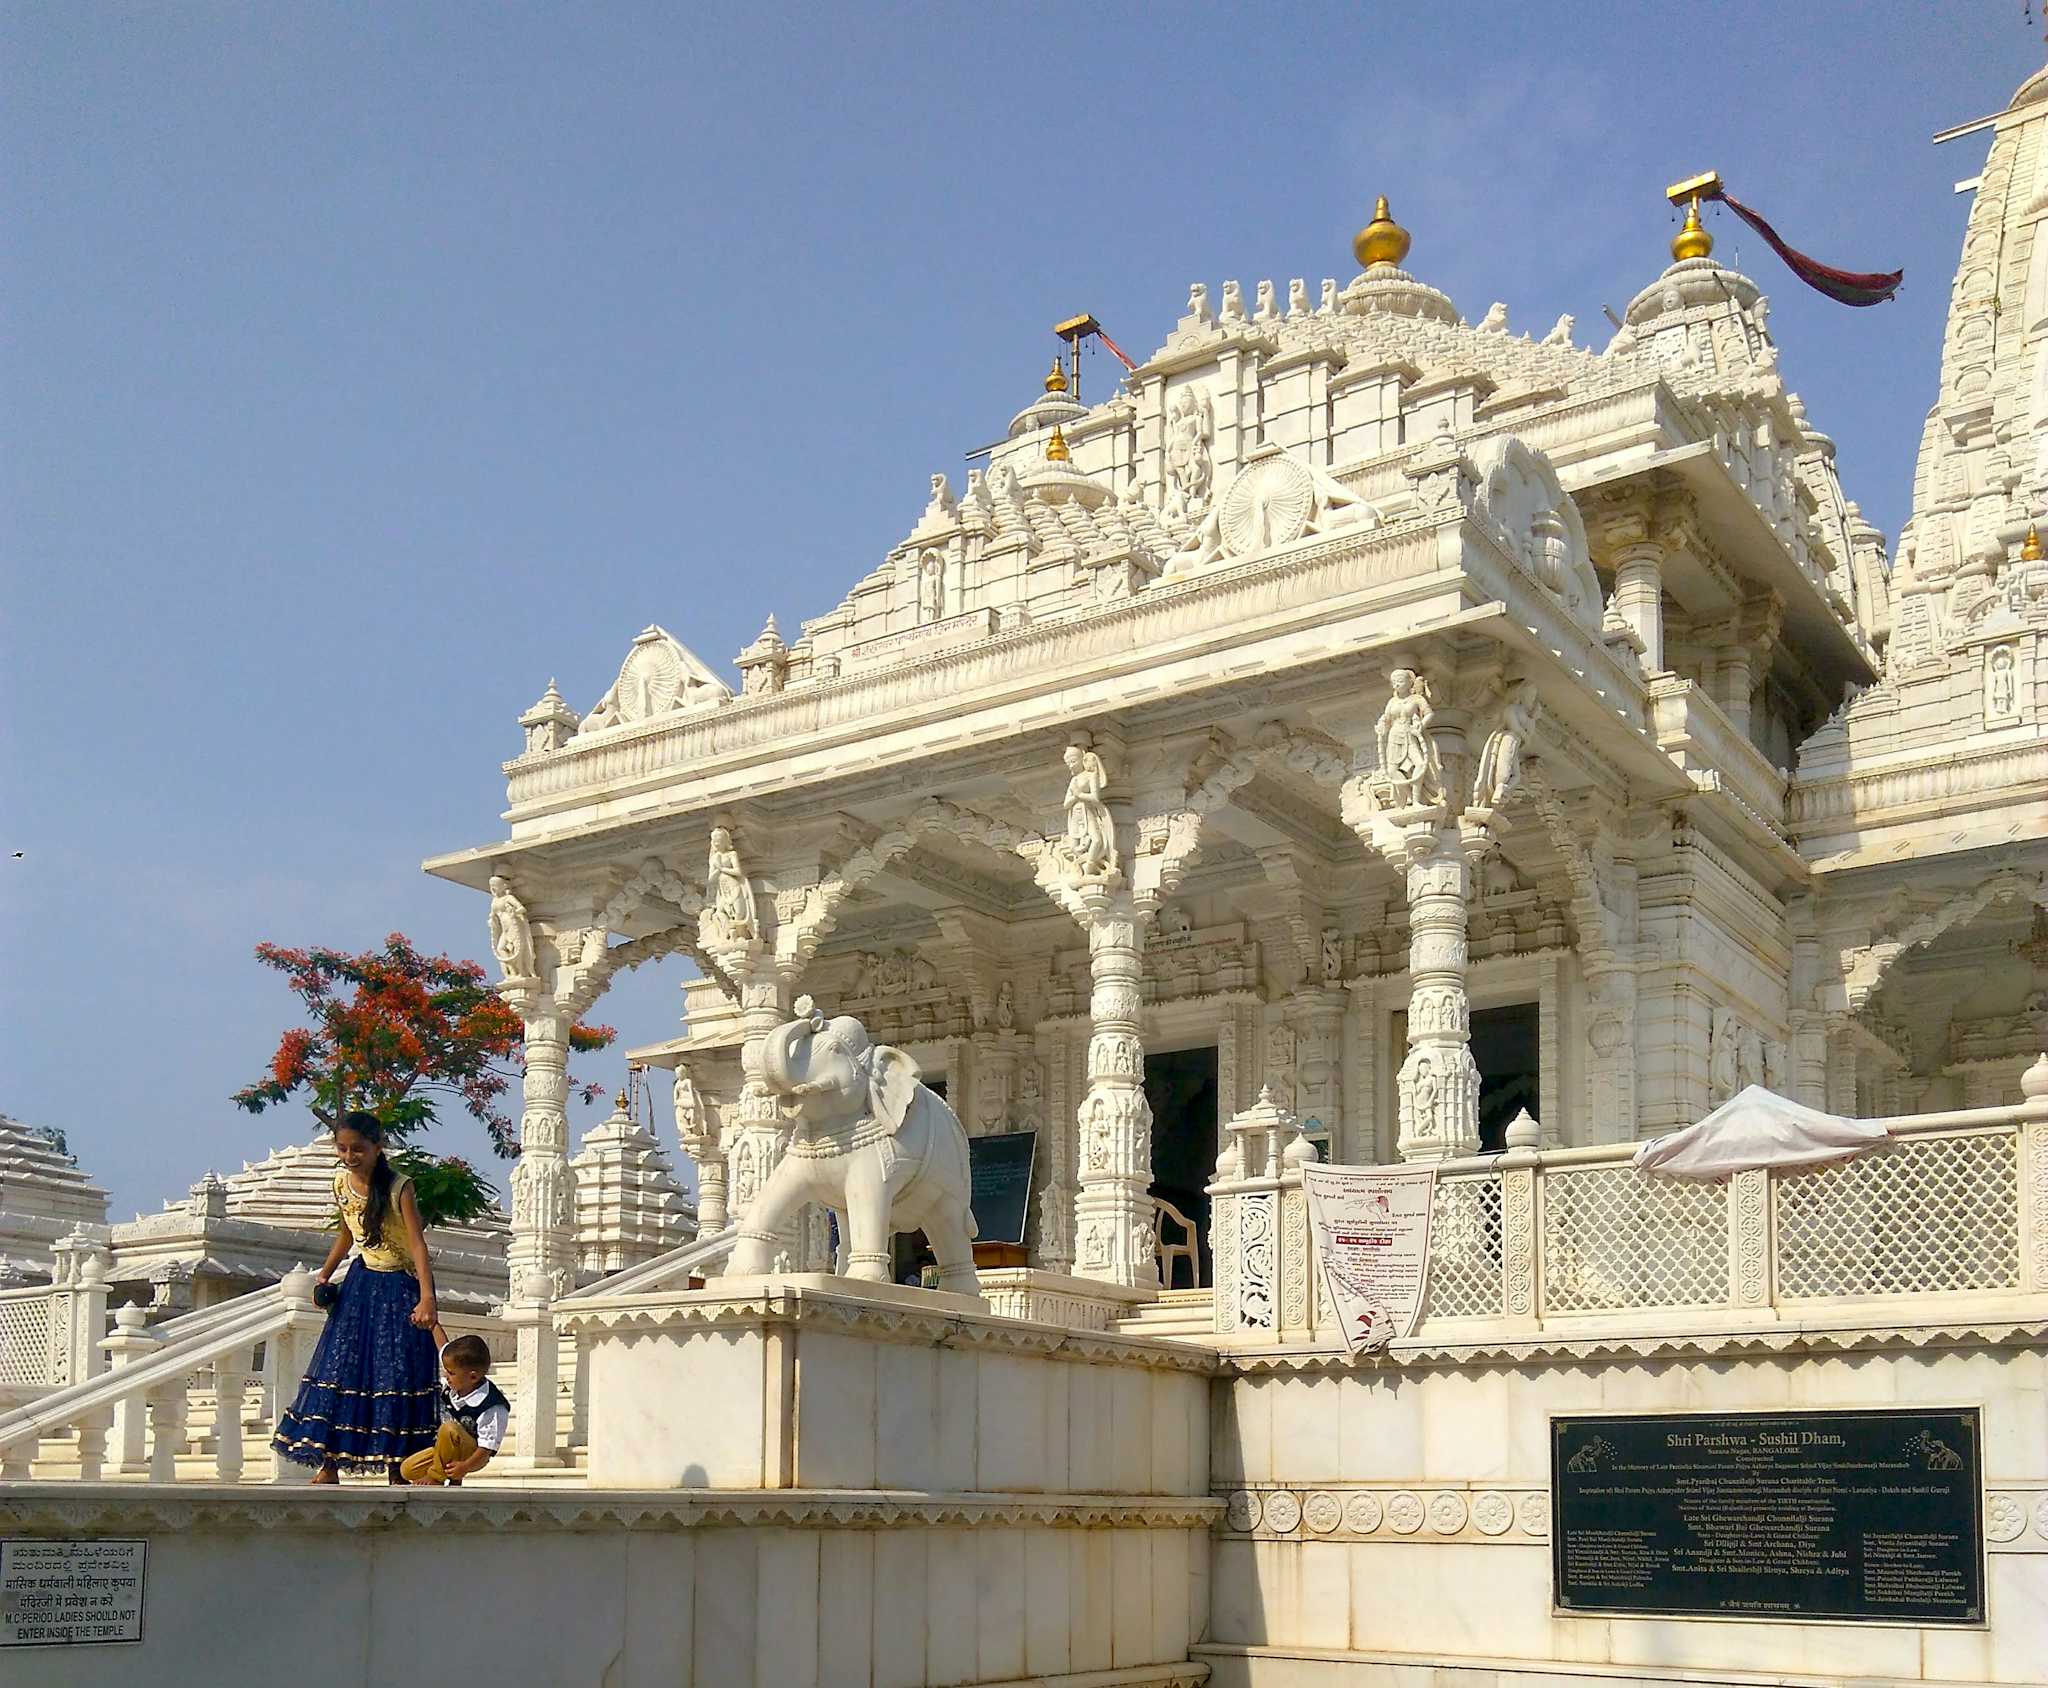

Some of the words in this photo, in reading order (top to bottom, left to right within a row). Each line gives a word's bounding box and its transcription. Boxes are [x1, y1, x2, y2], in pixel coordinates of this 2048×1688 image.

[1667, 1434, 1692, 1447] Shri
[1694, 1433, 1747, 1446] Parshwa
[1759, 1432, 1798, 1446] Sushil
[1802, 1432, 1846, 1448] Dham,
[6, 1576, 37, 1590] मासिक
[39, 1575, 74, 1589] धर्मवाली
[64, 1593, 88, 1608] प्रवेश
[90, 1597, 98, 1607] न
[54, 1612, 83, 1622] LADIES
[85, 1610, 118, 1622] SHOULD
[120, 1610, 136, 1620] NOT
[18, 1628, 45, 1640] ENTER
[46, 1626, 73, 1638] INSIDE
[76, 1626, 90, 1637] THE
[93, 1625, 124, 1637] TEMPLE
